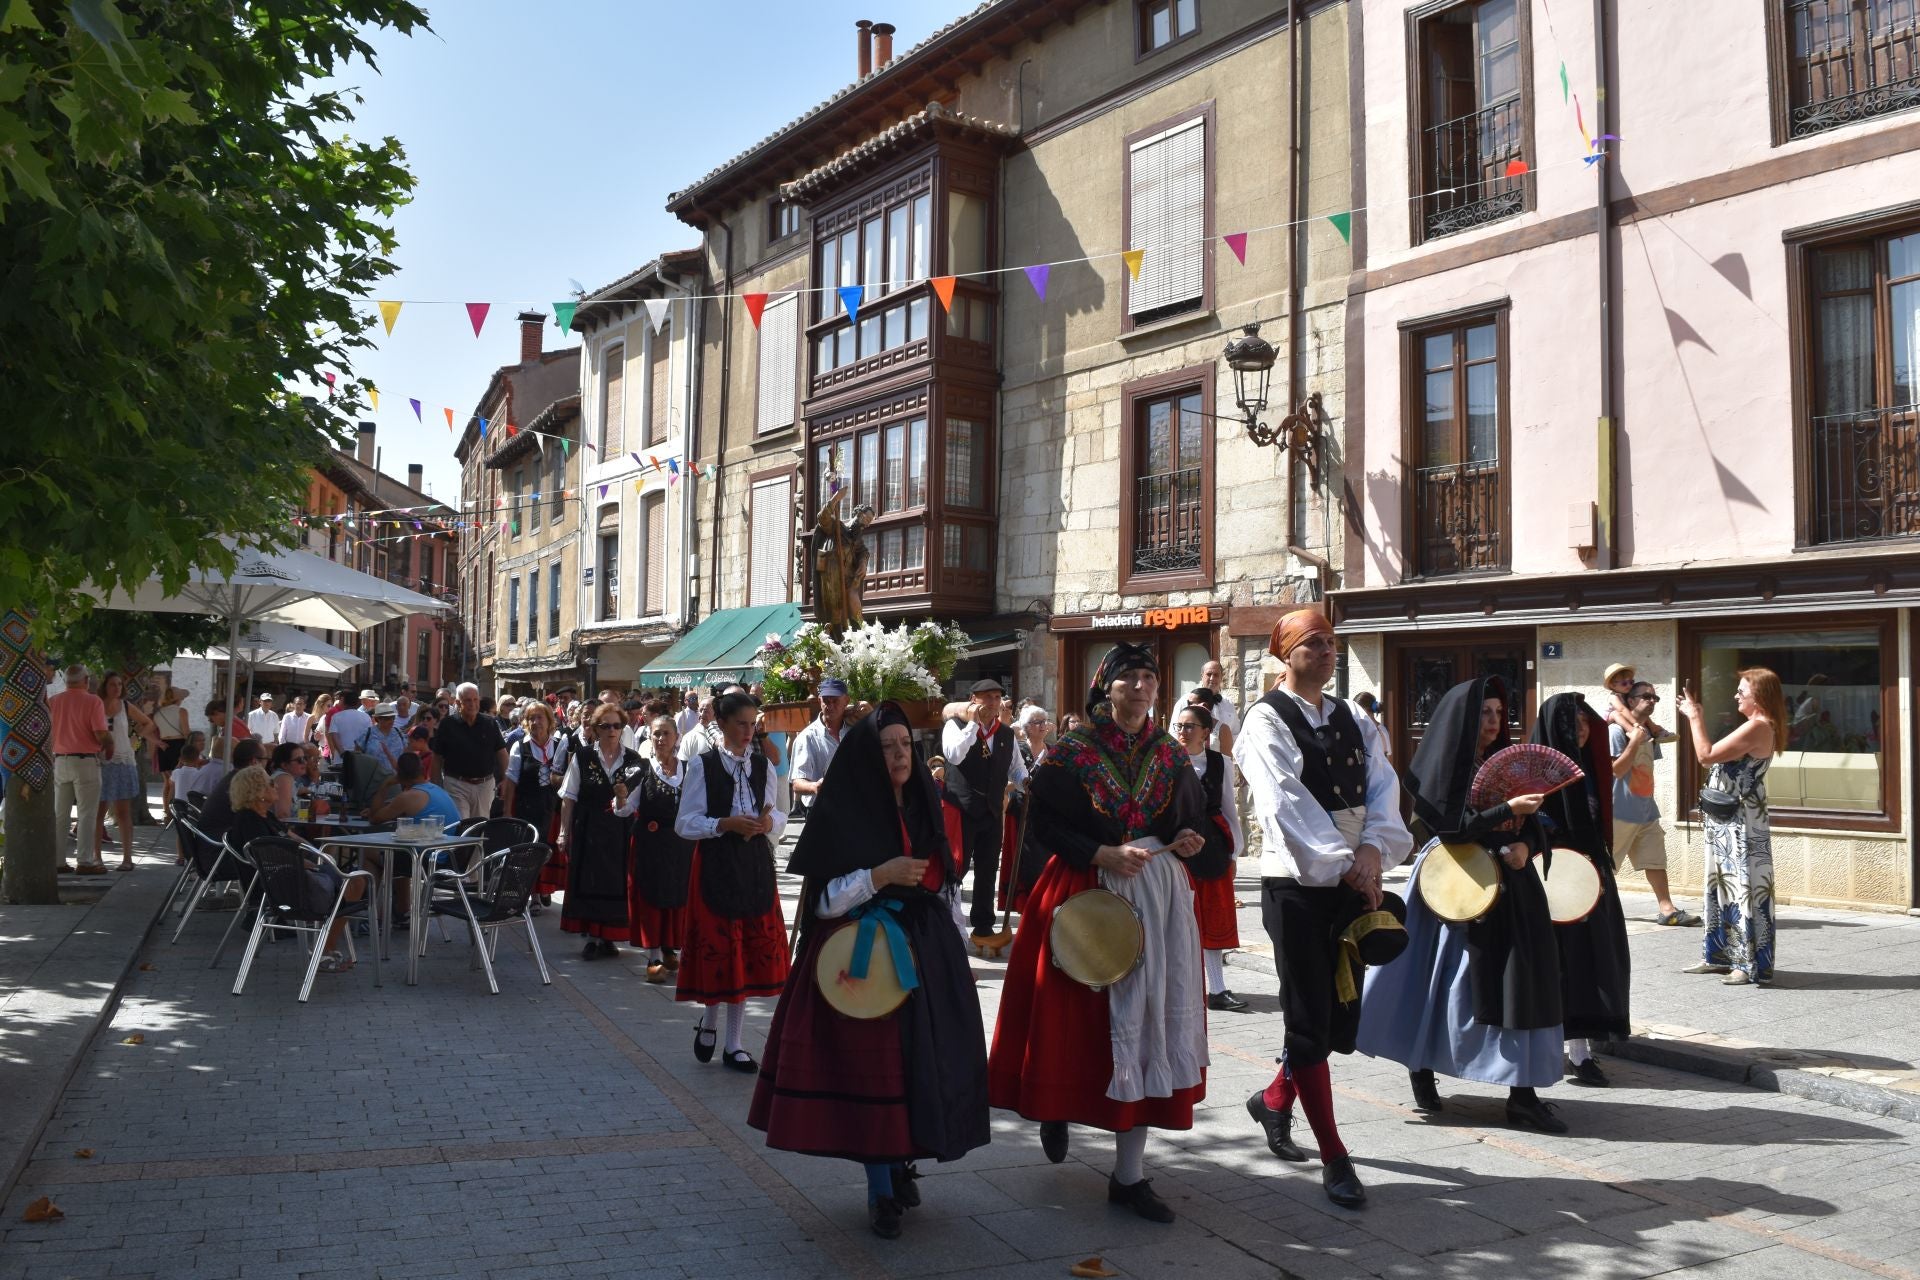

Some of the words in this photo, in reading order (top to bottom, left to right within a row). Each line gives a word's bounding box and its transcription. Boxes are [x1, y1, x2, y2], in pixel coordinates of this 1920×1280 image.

[1092, 613, 1142, 628] heladería
[1144, 607, 1209, 630] regma
[1548, 645, 1556, 656] 2
